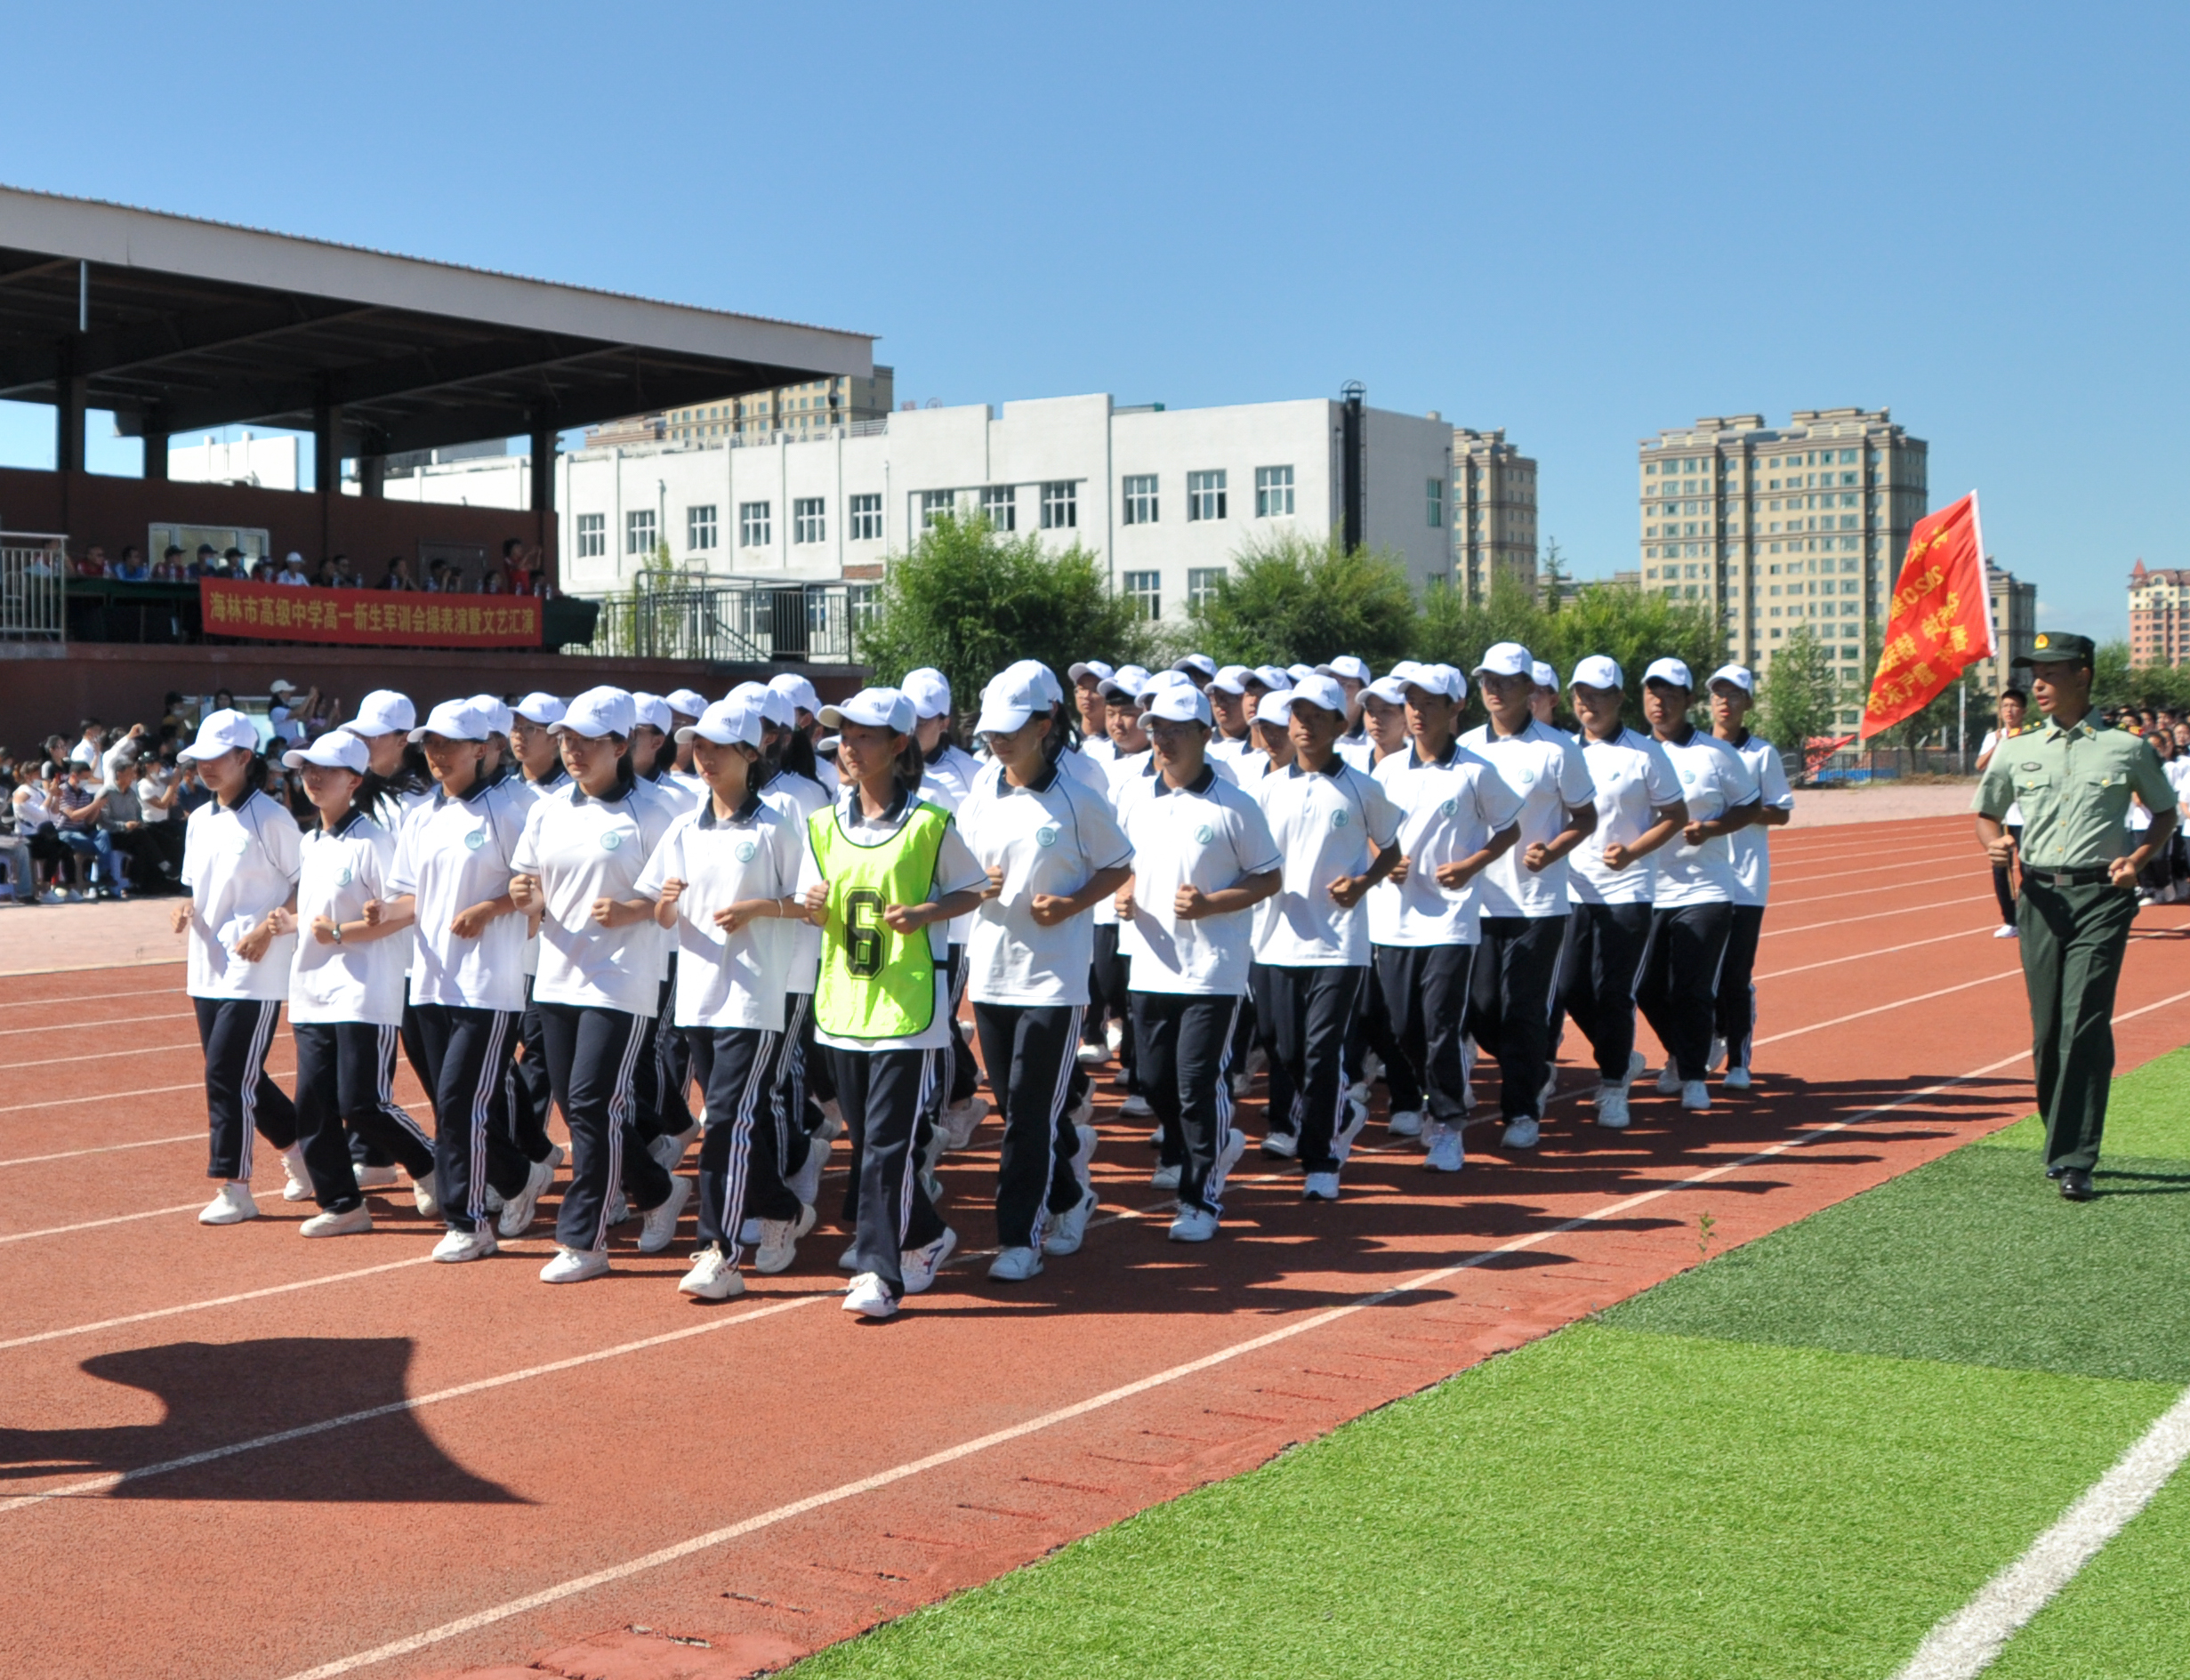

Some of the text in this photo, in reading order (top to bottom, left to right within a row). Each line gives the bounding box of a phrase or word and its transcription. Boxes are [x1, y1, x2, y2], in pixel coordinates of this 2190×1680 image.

[209, 591, 535, 635] 海林市高级中学高一新生军训会操表演暨文艺汇演
[842, 886, 886, 981] 6
